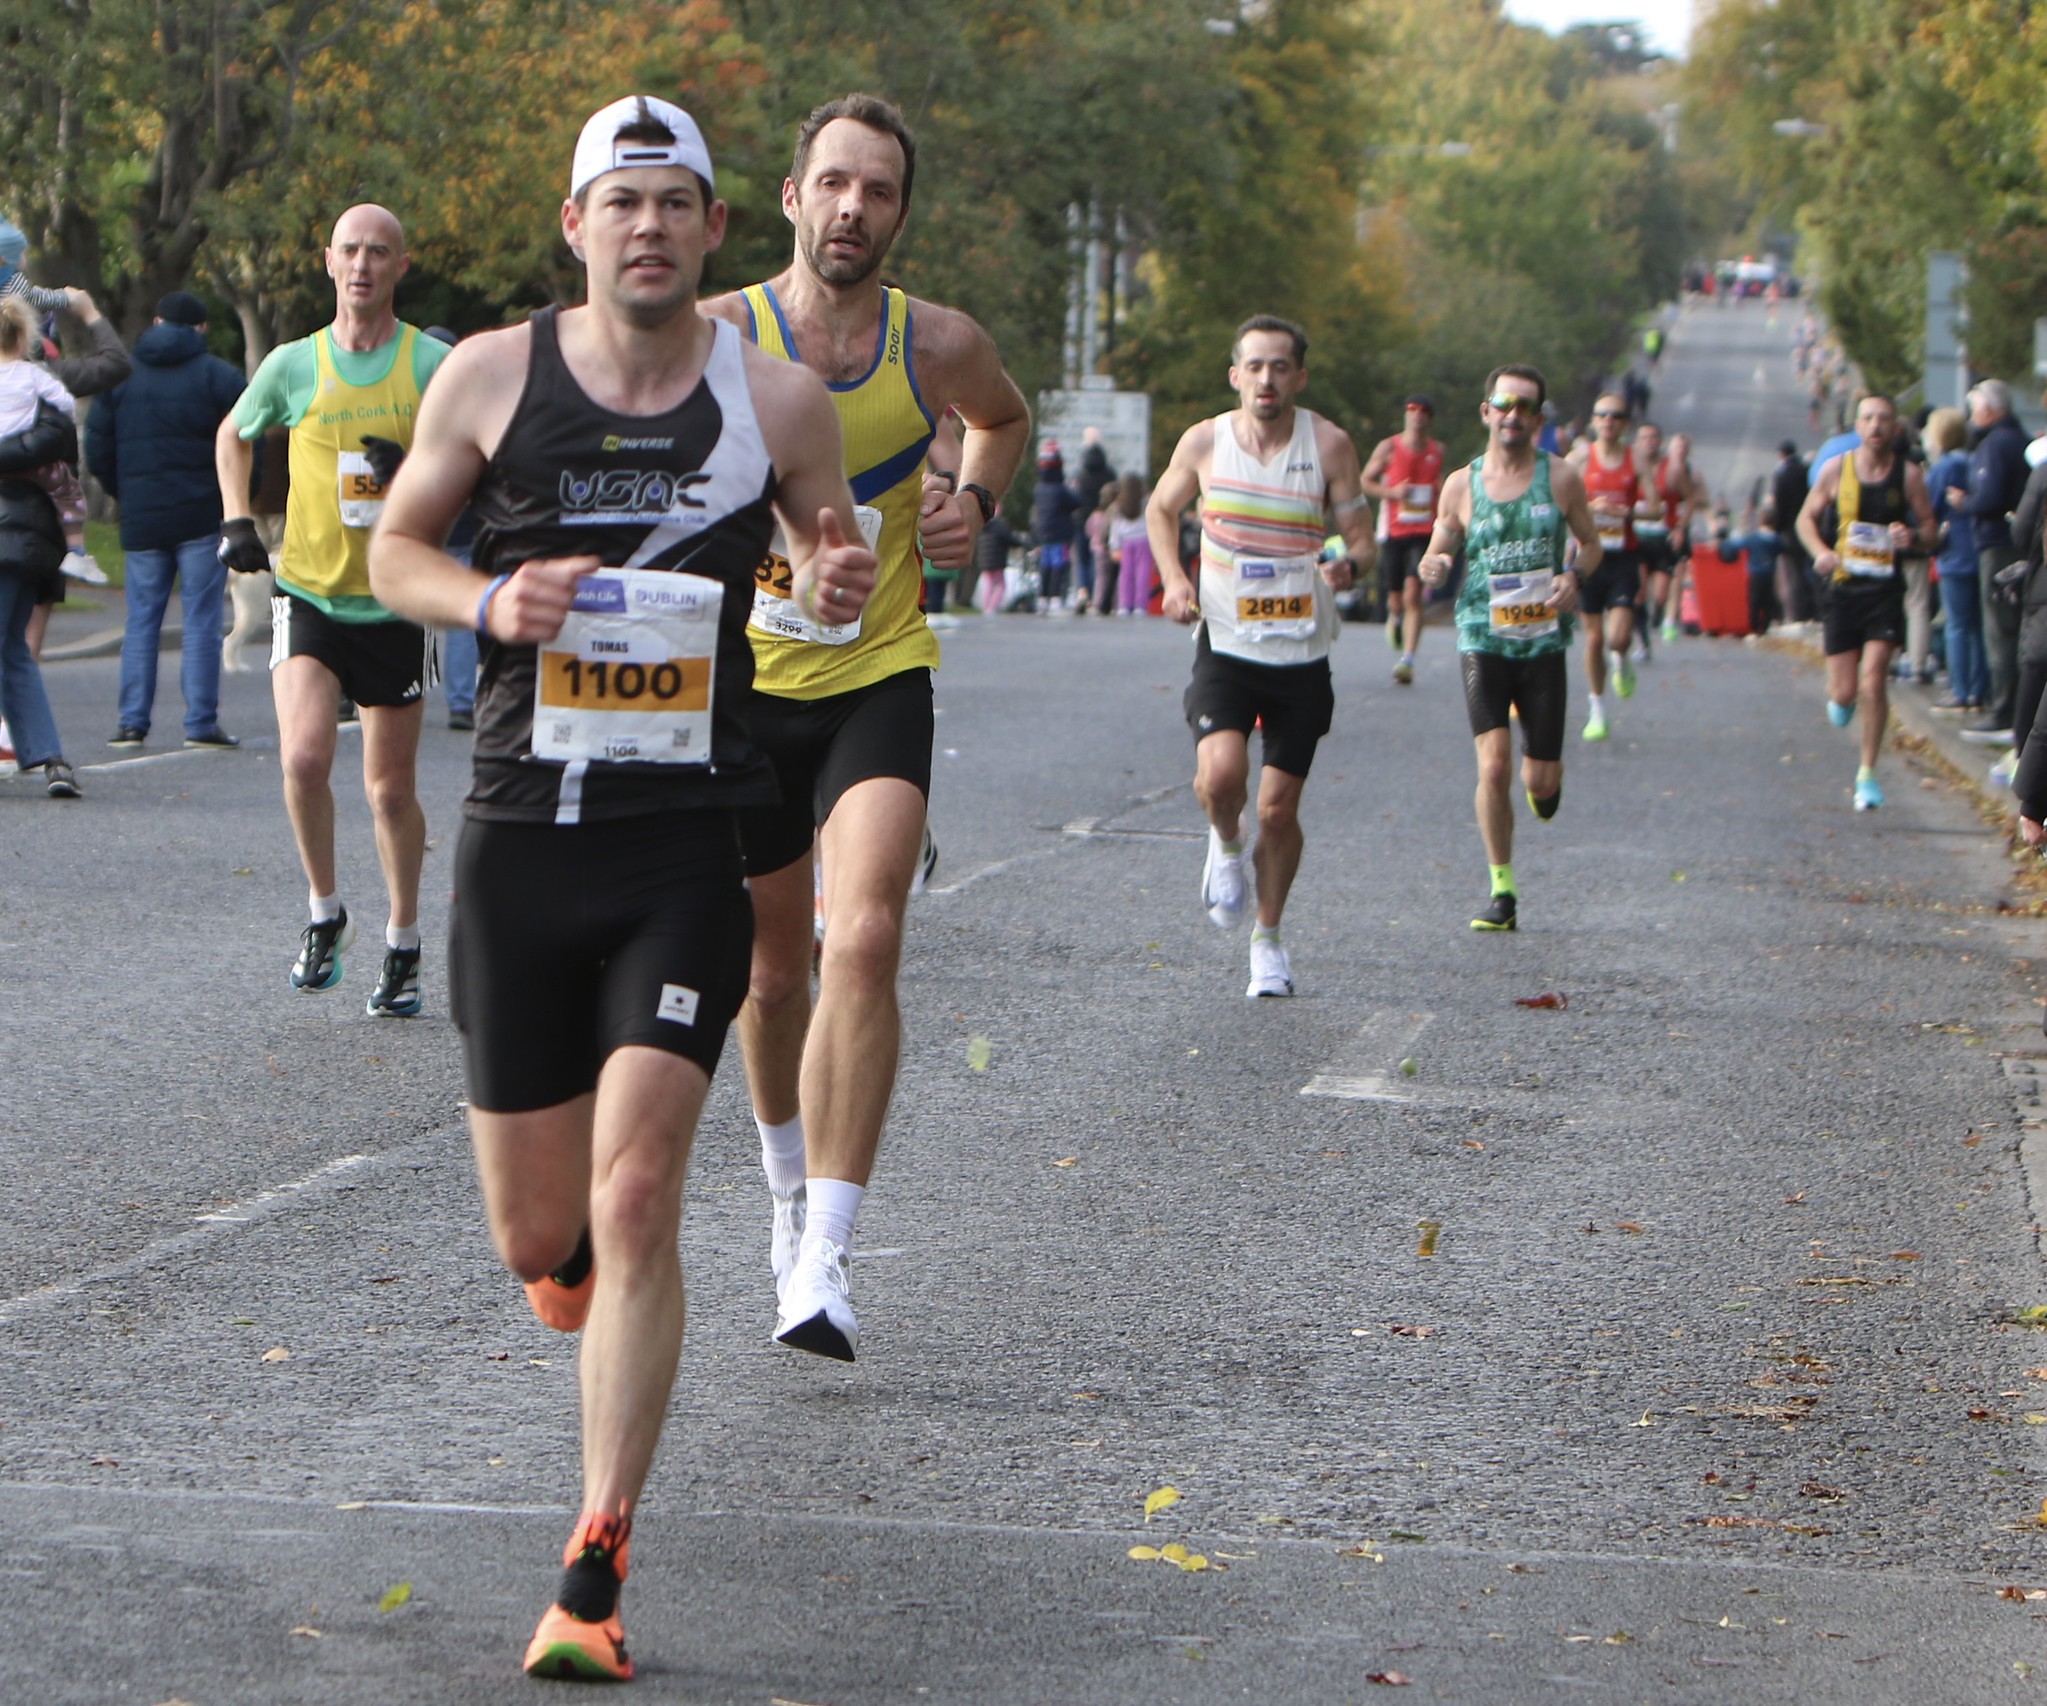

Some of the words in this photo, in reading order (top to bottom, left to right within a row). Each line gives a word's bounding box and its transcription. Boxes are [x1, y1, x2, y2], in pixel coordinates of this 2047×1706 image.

[888, 323, 900, 366] soar
[319, 408, 352, 425] North
[357, 404, 387, 419] Cork
[619, 437, 675, 449] INVERSE
[559, 470, 713, 511] USAC
[754, 555, 793, 591] 32
[597, 590, 617, 601] Life
[635, 588, 697, 606] DUBLIN
[1245, 597, 1302, 616] 2814
[1501, 602, 1545, 621] 1942
[775, 621, 802, 634] 3299
[591, 640, 629, 654] TOMAS
[562, 657, 683, 700] 1100
[603, 746, 639, 758] 1100
